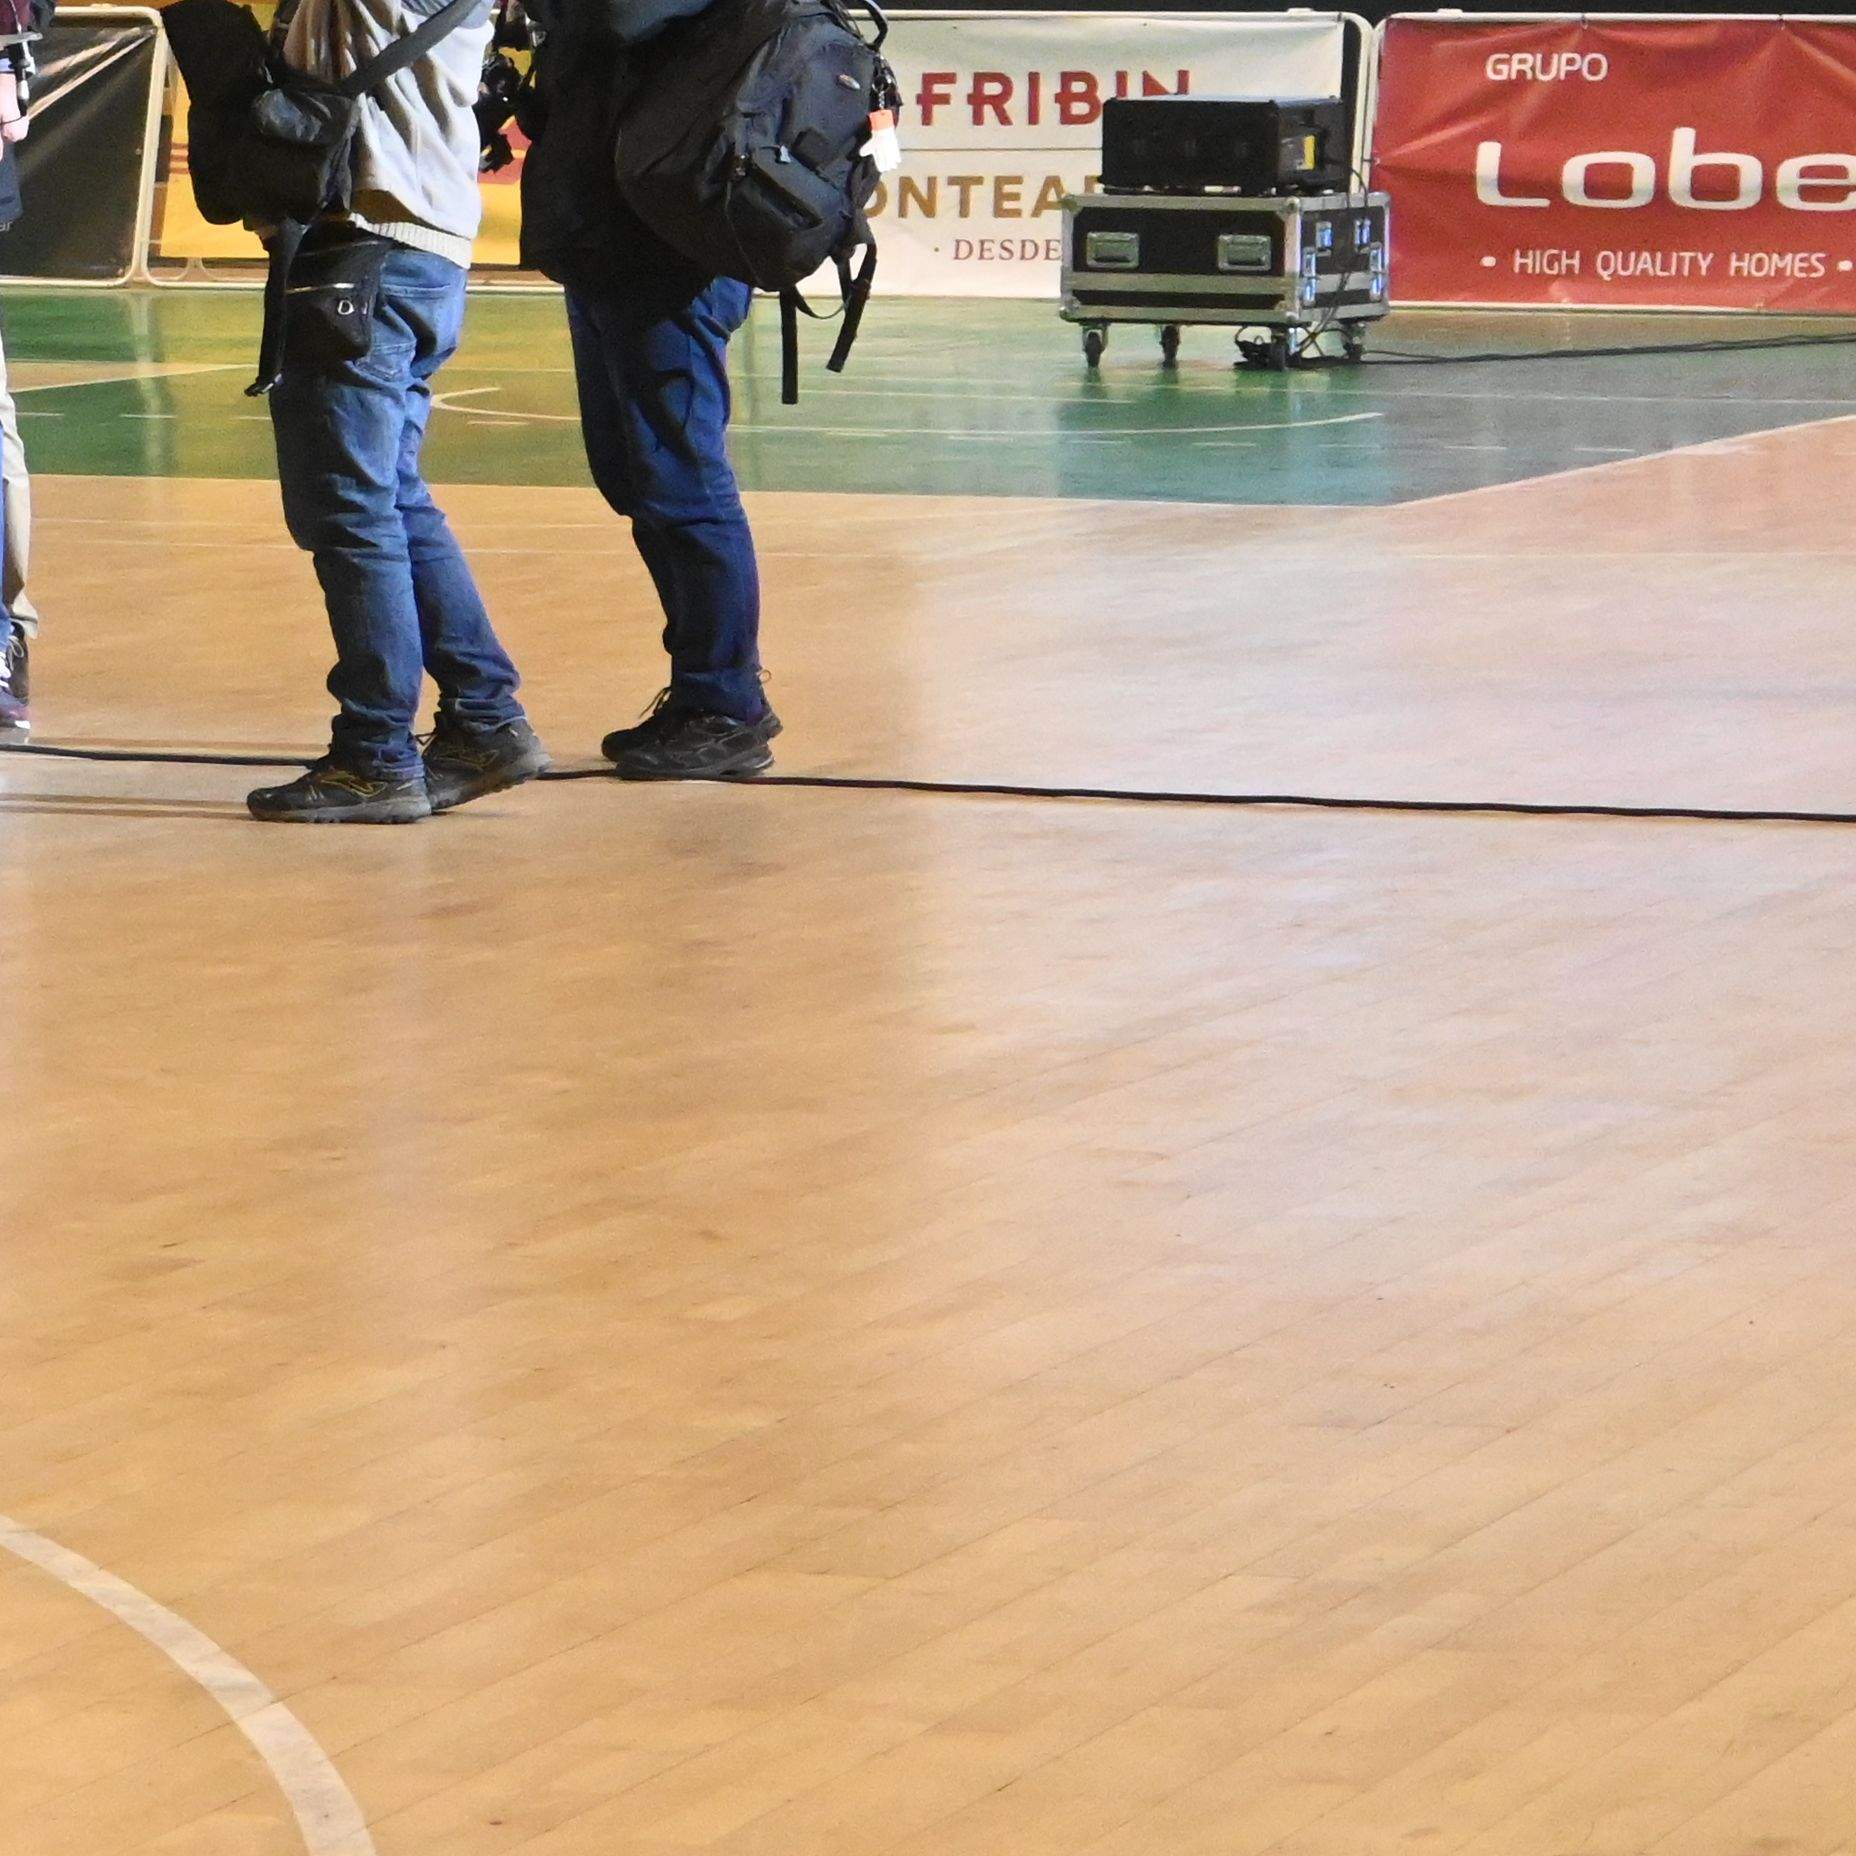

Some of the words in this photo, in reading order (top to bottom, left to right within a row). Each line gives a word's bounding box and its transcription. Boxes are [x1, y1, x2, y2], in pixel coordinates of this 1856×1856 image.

[1485, 52, 1609, 82] GRUPO
[1475, 126, 1856, 212] Lobe
[953, 239, 1061, 261] DESDE
[1513, 249, 1581, 276] HIGH
[1595, 250, 1713, 280] QUALITY
[1728, 252, 1827, 279] HOMES
